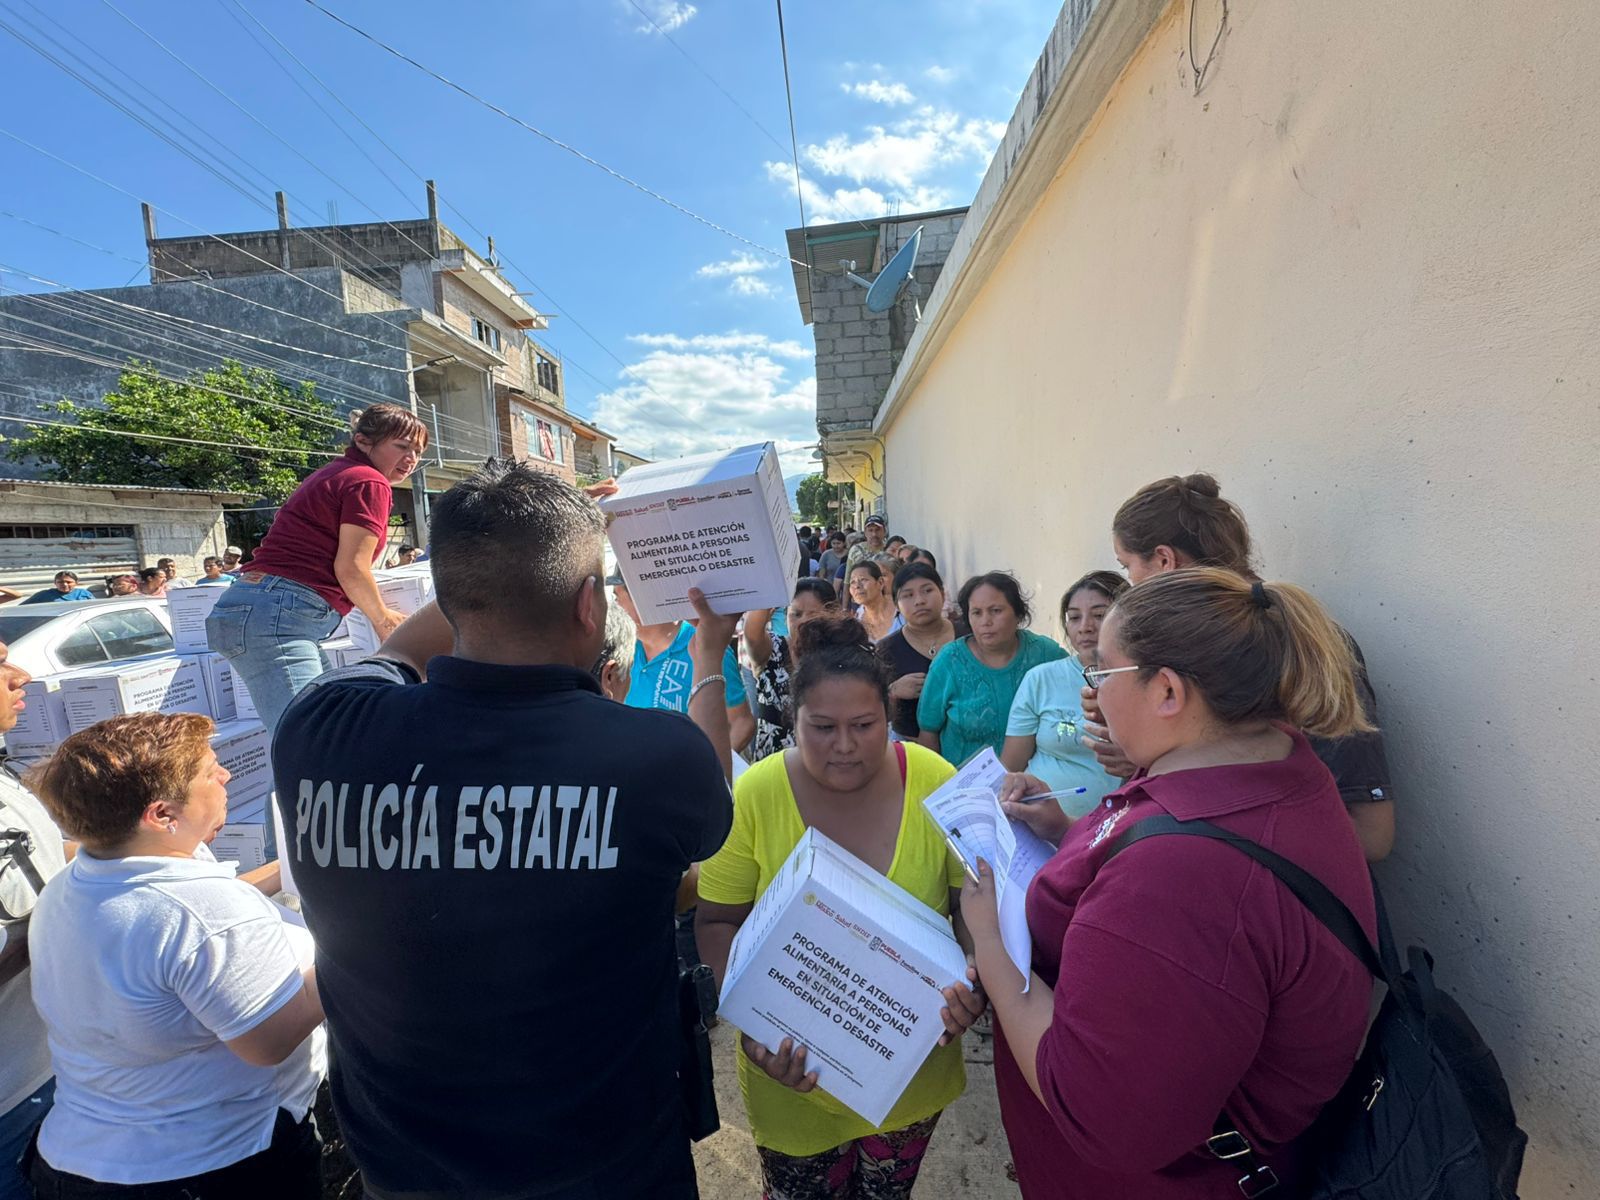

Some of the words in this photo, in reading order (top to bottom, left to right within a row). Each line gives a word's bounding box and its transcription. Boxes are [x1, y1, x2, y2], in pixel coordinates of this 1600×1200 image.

[627, 533, 680, 549] PROGRAMA
[682, 530, 695, 540] DE
[697, 521, 746, 537] ATENCIÓN
[630, 543, 689, 560] ALIMENTARIA
[691, 542, 699, 550] A
[700, 533, 750, 549] PERSONAS
[654, 559, 666, 568] EN
[668, 550, 717, 566] SITUACIÓN
[718, 548, 732, 557] DE
[639, 566, 697, 581] EMERGENCIA
[699, 563, 707, 572] O
[708, 556, 755, 570] DESASTRE
[296, 763, 441, 871] POLICÍA
[453, 784, 619, 871] ESTATAL
[782, 943, 847, 993] ALIMENTARIA
[848, 990, 856, 1000] A
[858, 995, 912, 1037] PERSONAS
[792, 932, 851, 978] PROGRAMA
[851, 973, 868, 989] DE
[866, 984, 919, 1024] ATENCIÓN
[796, 970, 812, 985] EN
[811, 981, 866, 1024] SITUACIÓN
[865, 1018, 882, 1034] DE
[768, 967, 832, 1018] EMERGENCIA
[833, 1013, 843, 1024] O
[843, 1020, 895, 1061] DESASTRE
